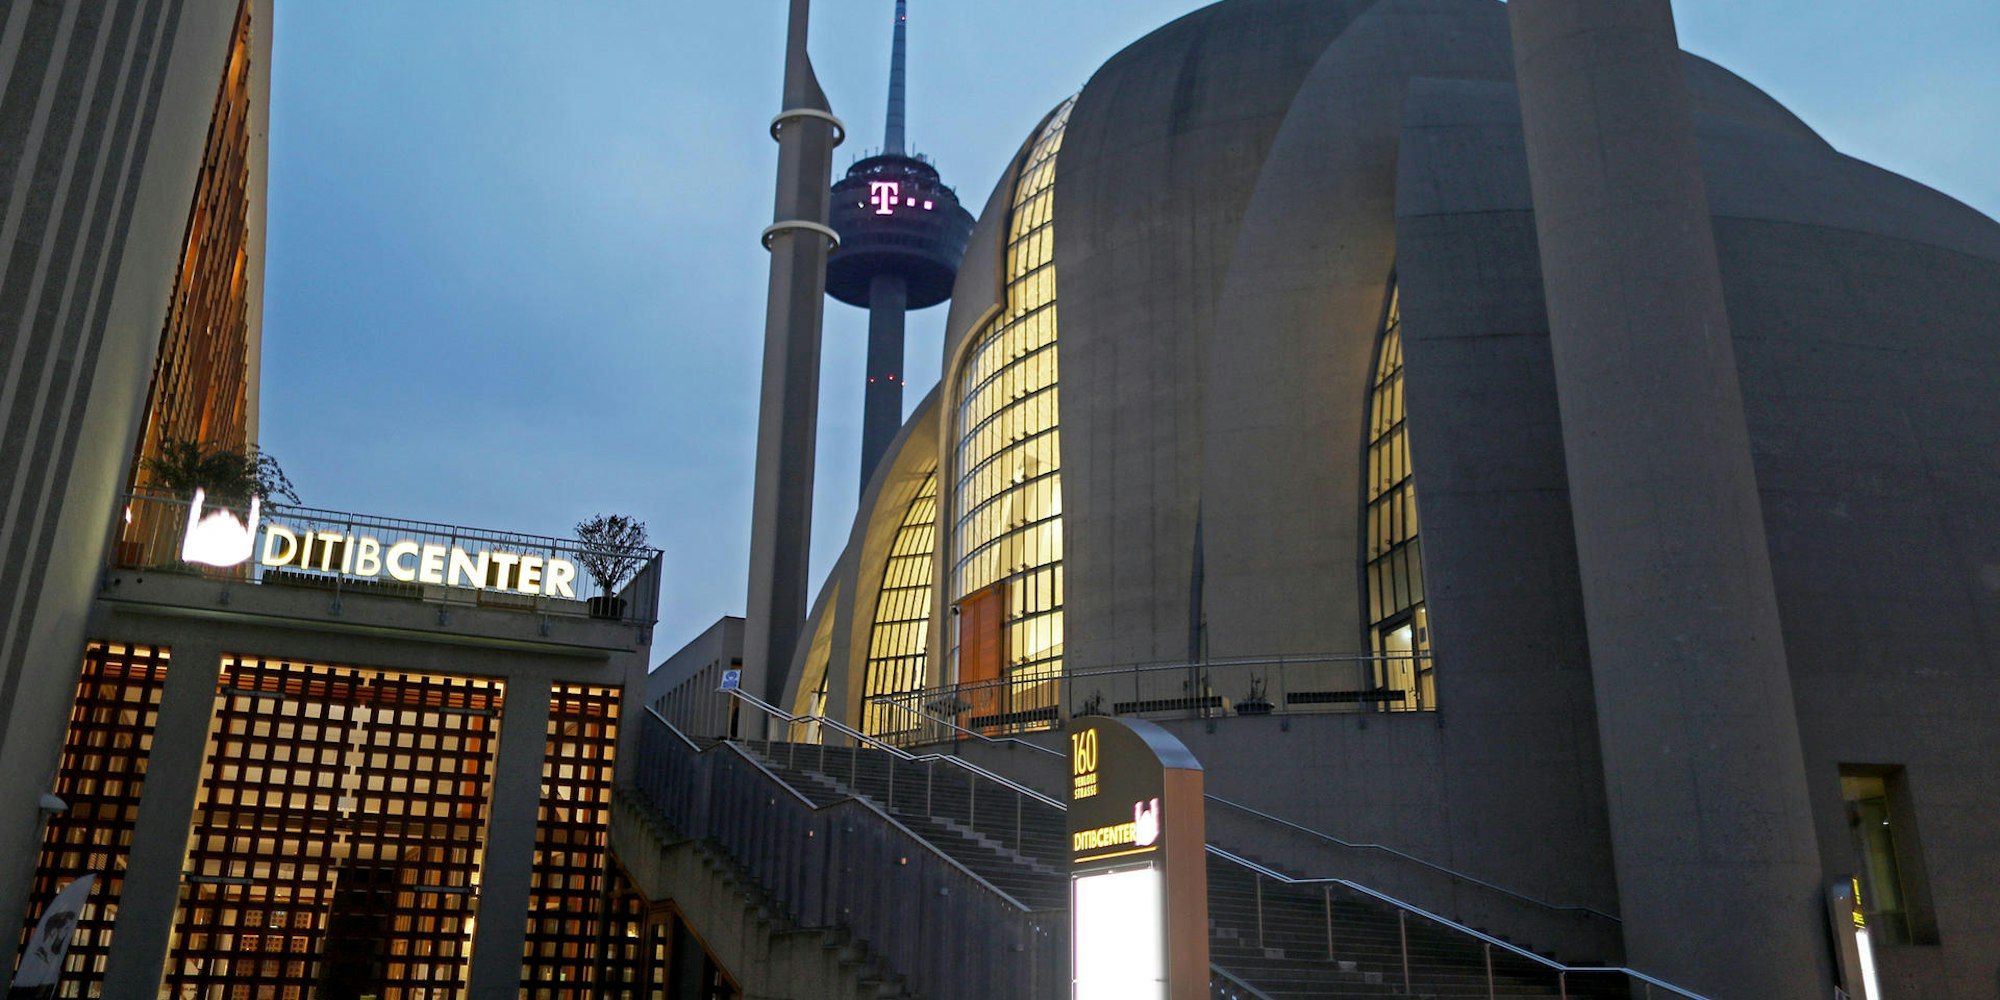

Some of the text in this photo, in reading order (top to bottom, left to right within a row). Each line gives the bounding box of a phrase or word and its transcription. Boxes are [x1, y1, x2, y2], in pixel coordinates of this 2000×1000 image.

[262, 526, 575, 598] DITIBCENTER
[1072, 728, 1097, 776] 160
[1074, 784, 1097, 800] STRASSE
[1074, 822, 1137, 851] DITIBCENTER
